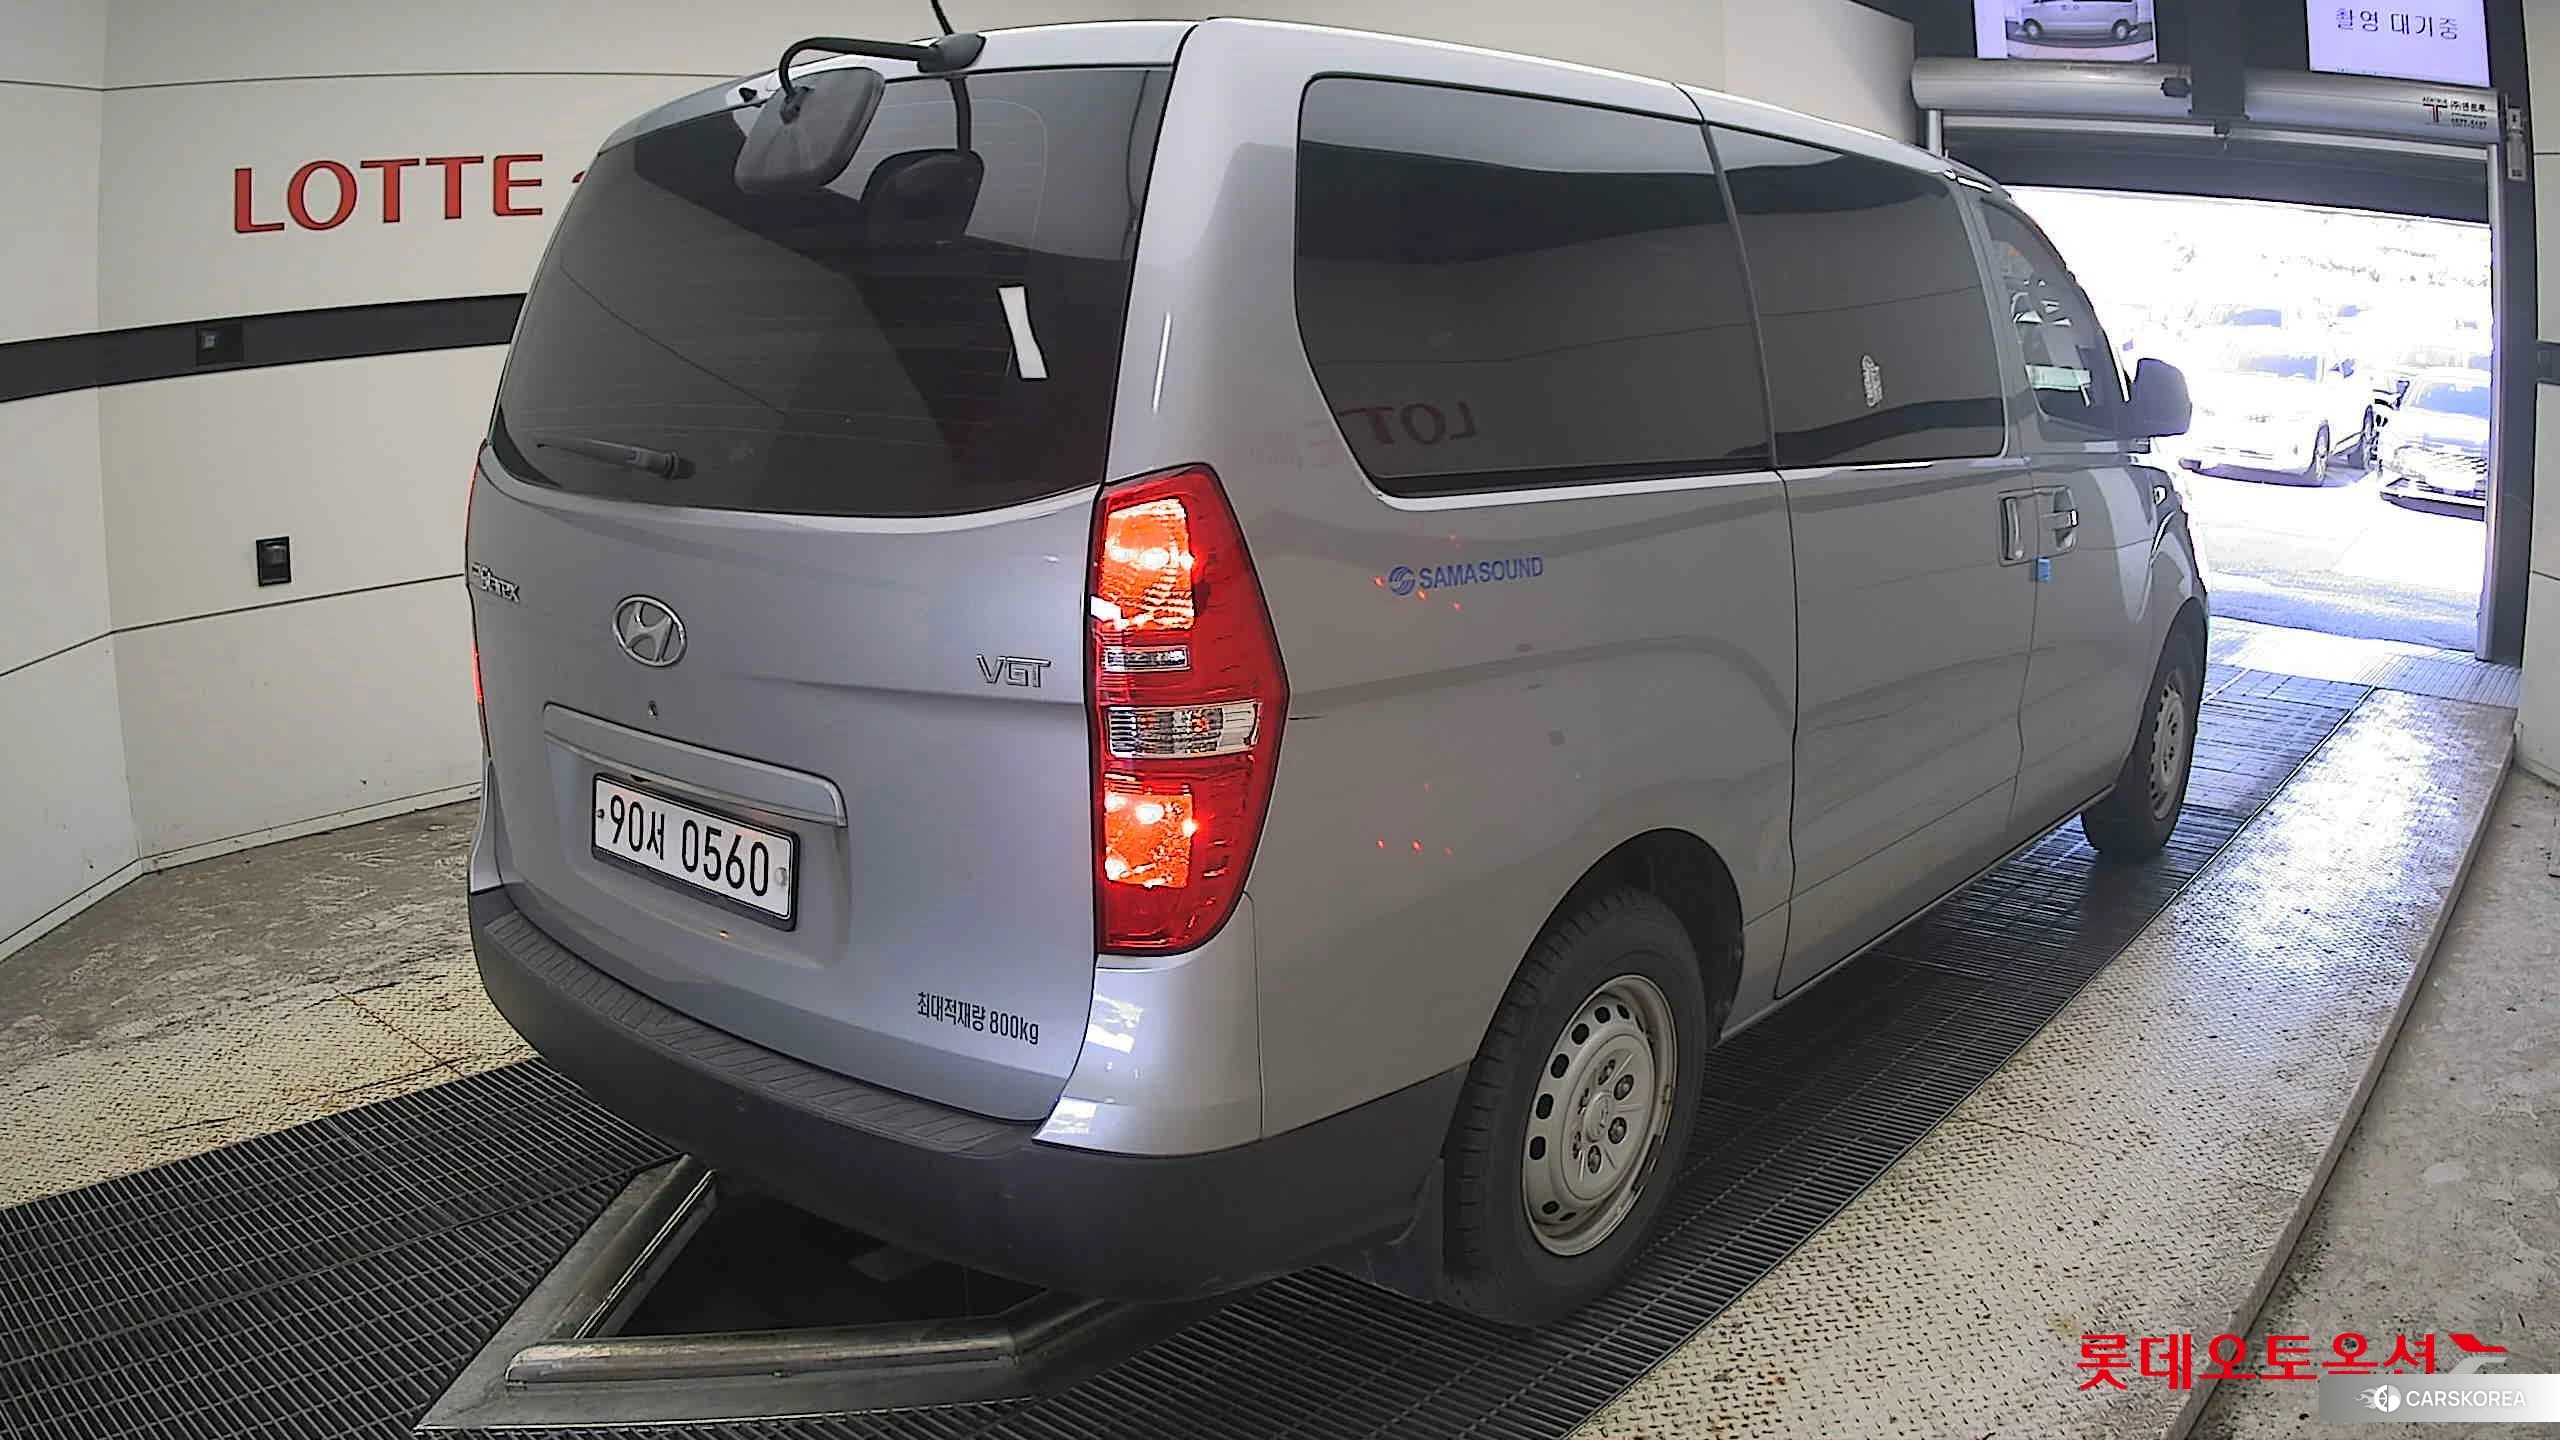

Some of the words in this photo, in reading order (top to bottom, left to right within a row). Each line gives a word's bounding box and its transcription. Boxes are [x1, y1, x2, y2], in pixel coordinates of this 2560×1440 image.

[234, 153, 543, 234] LOTTE
[1419, 556, 1545, 590] SAMASOUND
[976, 654, 1052, 689] VGT
[609, 794, 666, 861] 90서
[681, 818, 770, 898] 0560
[917, 991, 987, 1032] 최대적재량
[989, 1010, 1040, 1046] 800kg
